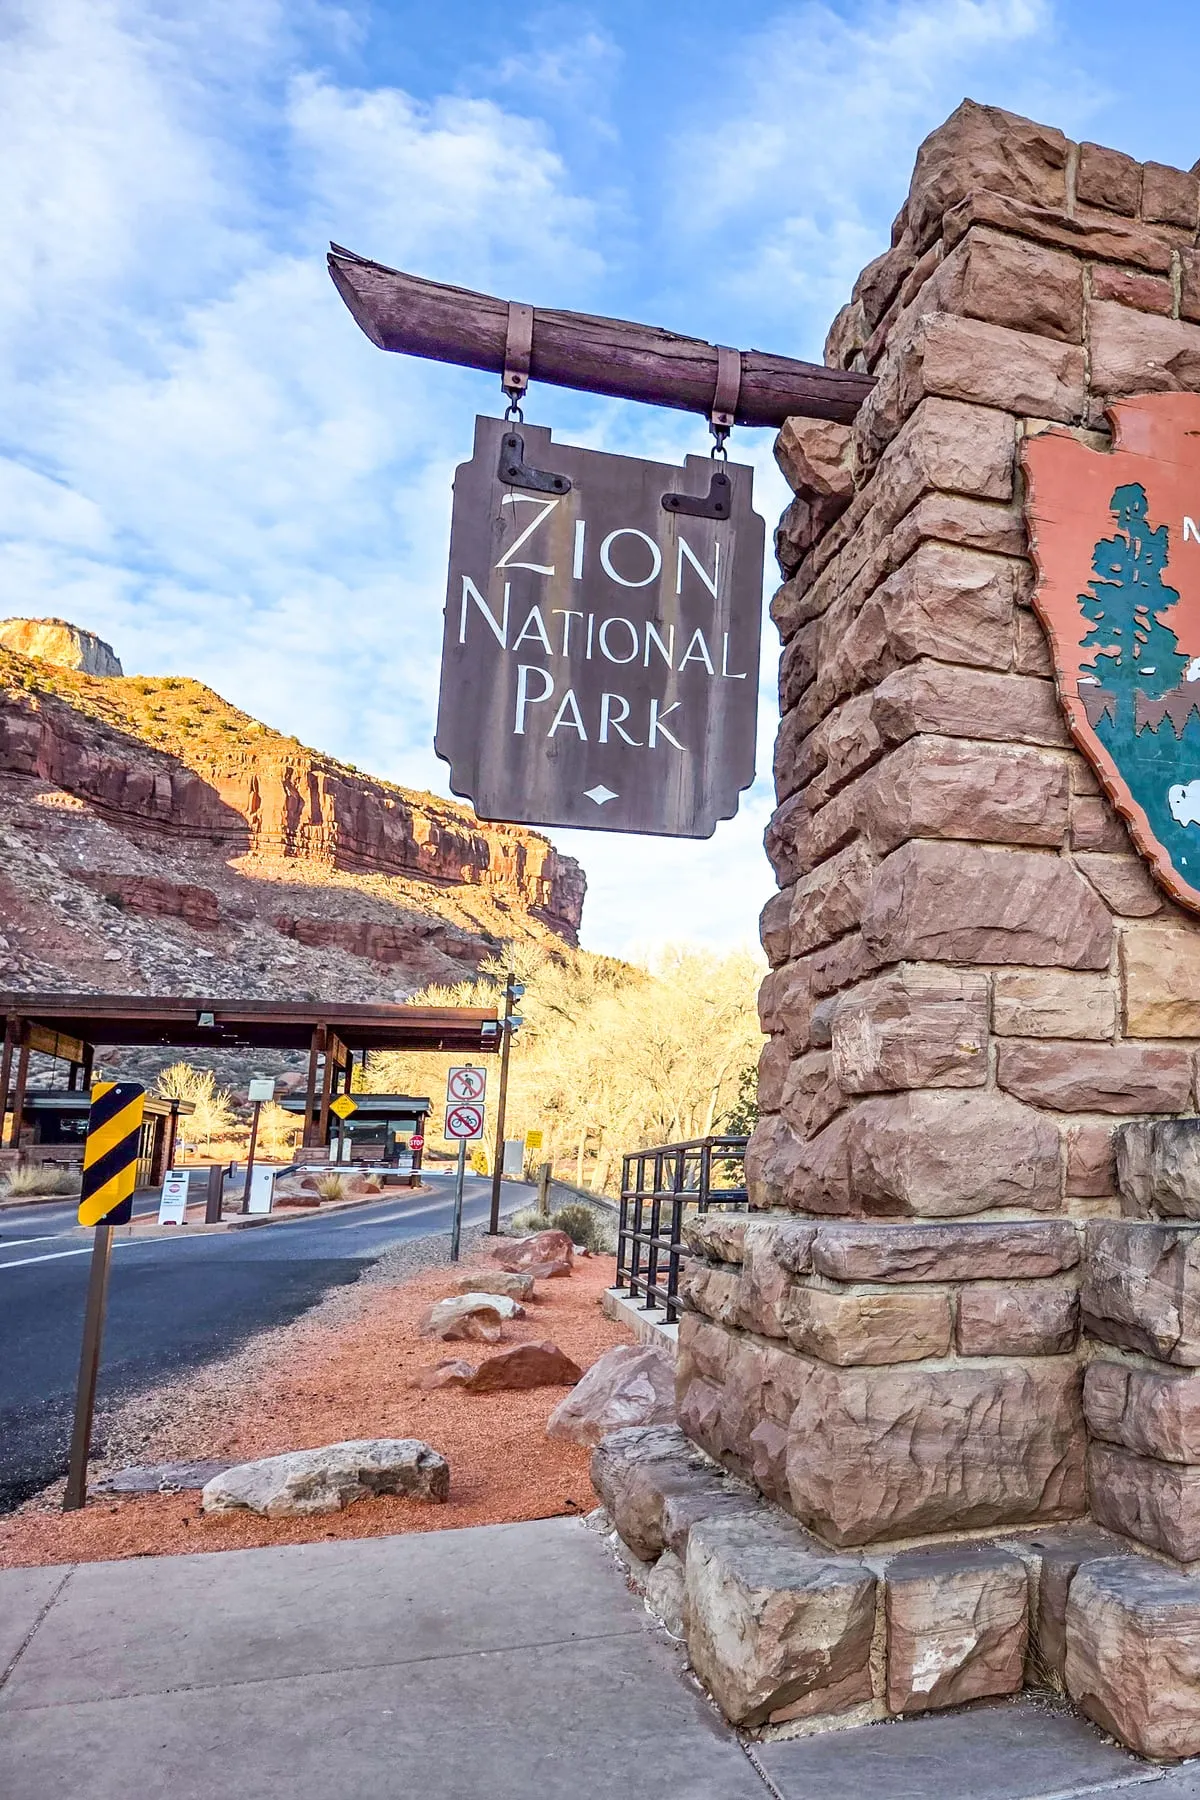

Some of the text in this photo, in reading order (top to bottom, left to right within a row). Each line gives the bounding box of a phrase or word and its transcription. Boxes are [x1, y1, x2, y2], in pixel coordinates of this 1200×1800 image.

[494, 493, 721, 600] ZION
[458, 574, 748, 680] NATIONAL
[513, 664, 688, 752] PARK
